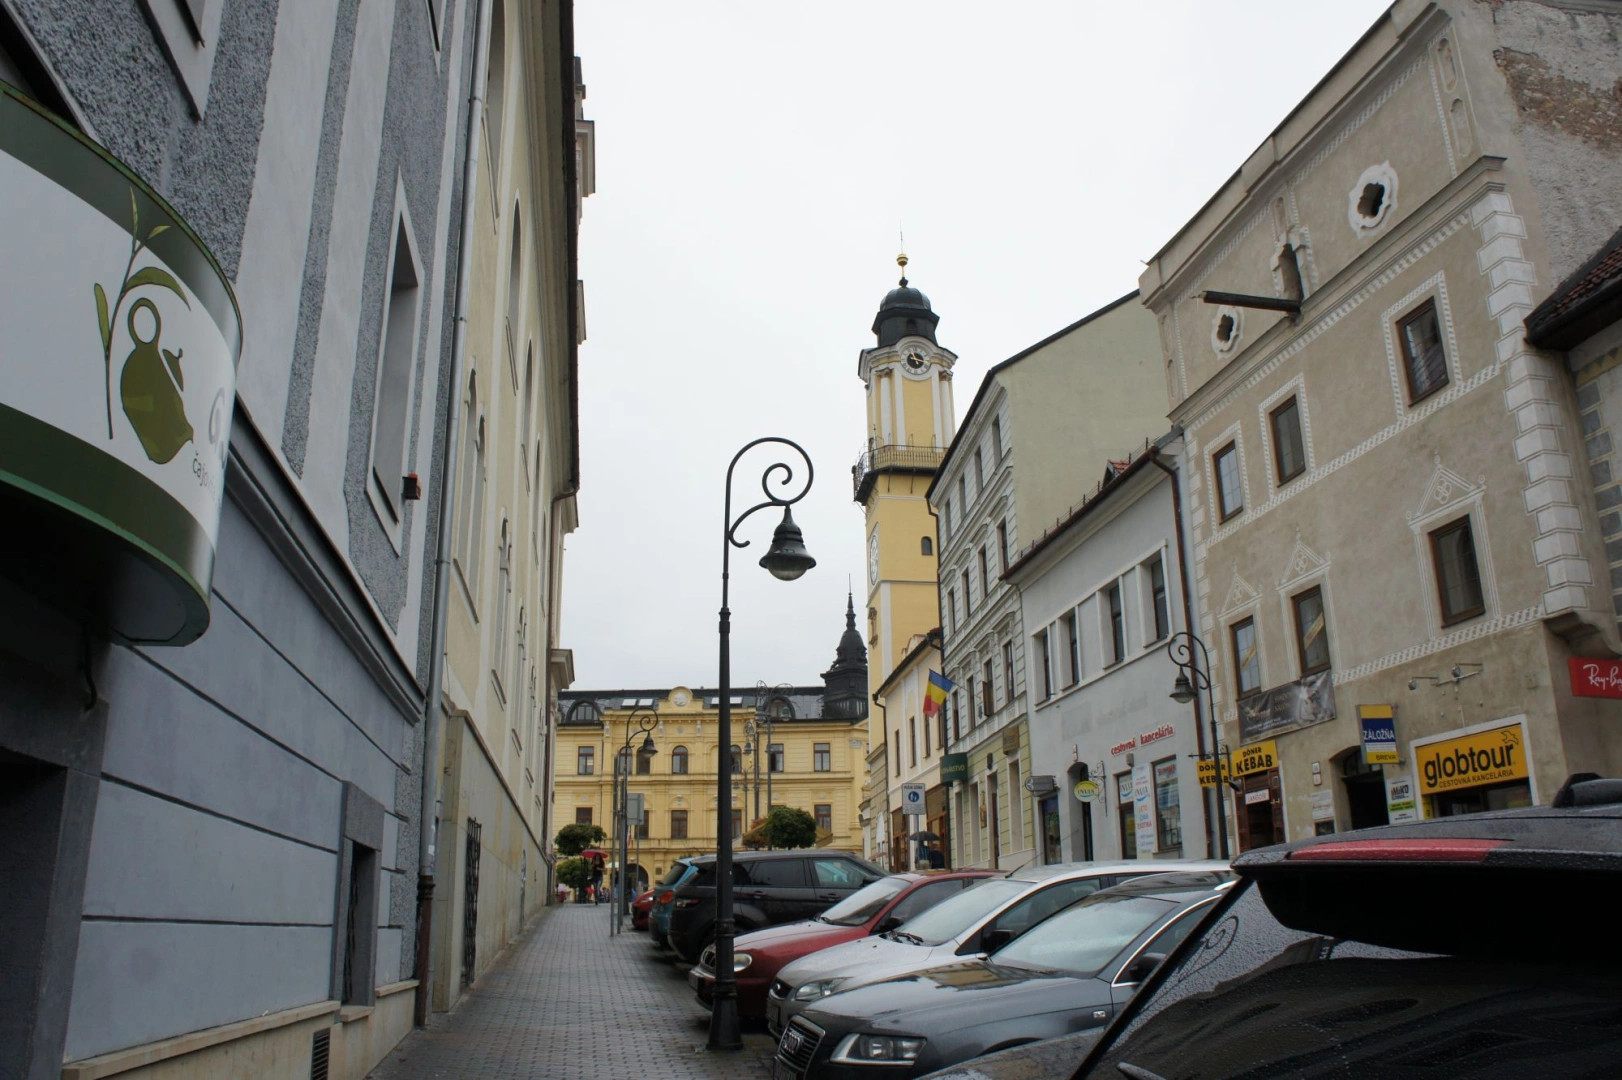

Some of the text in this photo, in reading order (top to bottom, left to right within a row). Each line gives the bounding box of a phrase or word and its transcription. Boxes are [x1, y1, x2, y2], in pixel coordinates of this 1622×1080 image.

[1111, 725, 1173, 756] cestovná kancelária
[1243, 747, 1262, 758] DÖNER
[1199, 764, 1226, 772] DÖNR
[1236, 754, 1273, 774] KEBAB
[1424, 743, 1514, 788] globtour
[1199, 776, 1229, 785] KEBB
[1439, 769, 1514, 788] CESTOVNÁ KANCELÁRIA
